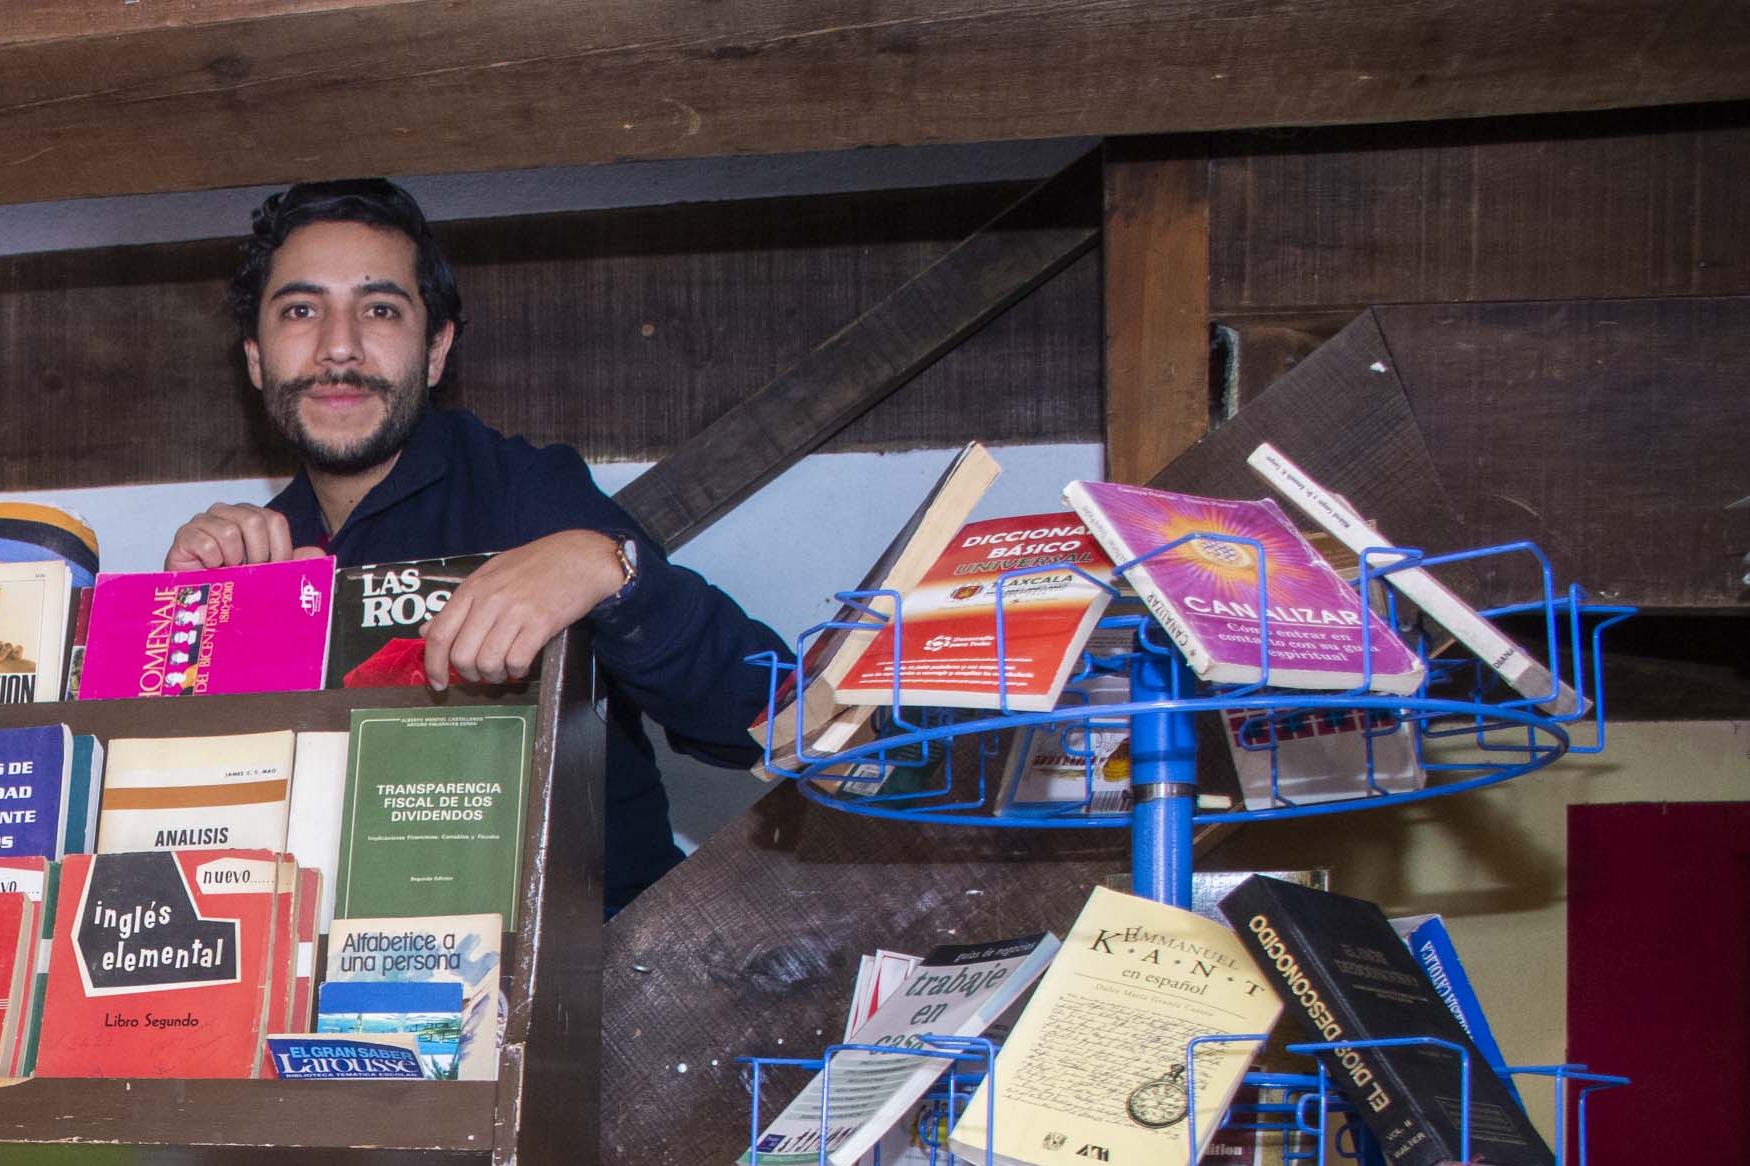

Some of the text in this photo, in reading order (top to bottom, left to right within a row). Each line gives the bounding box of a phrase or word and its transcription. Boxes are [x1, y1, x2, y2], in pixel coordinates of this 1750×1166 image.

[987, 541, 1081, 560] BÁSICO
[362, 568, 420, 597] LAS
[194, 581, 225, 694] DEL BICENTENARIO
[8, 761, 33, 775] DE
[377, 783, 501, 796] TRANSPARENCIA
[384, 796, 492, 808] FISCAL DE LOS
[391, 809, 483, 822] DIVIDENDOS
[155, 827, 229, 847] ANALISIS
[203, 868, 251, 884] nuevo
[94, 901, 172, 939] inglés
[342, 933, 455, 953] Alfabetice a
[102, 939, 224, 972] elemental
[341, 952, 461, 976] una persona
[905, 961, 1008, 998] trabaje
[1122, 967, 1209, 997] en español
[105, 1013, 199, 1029] Libro Segundo
[910, 1001, 949, 1026] en
[278, 1053, 419, 1074] Larousse
